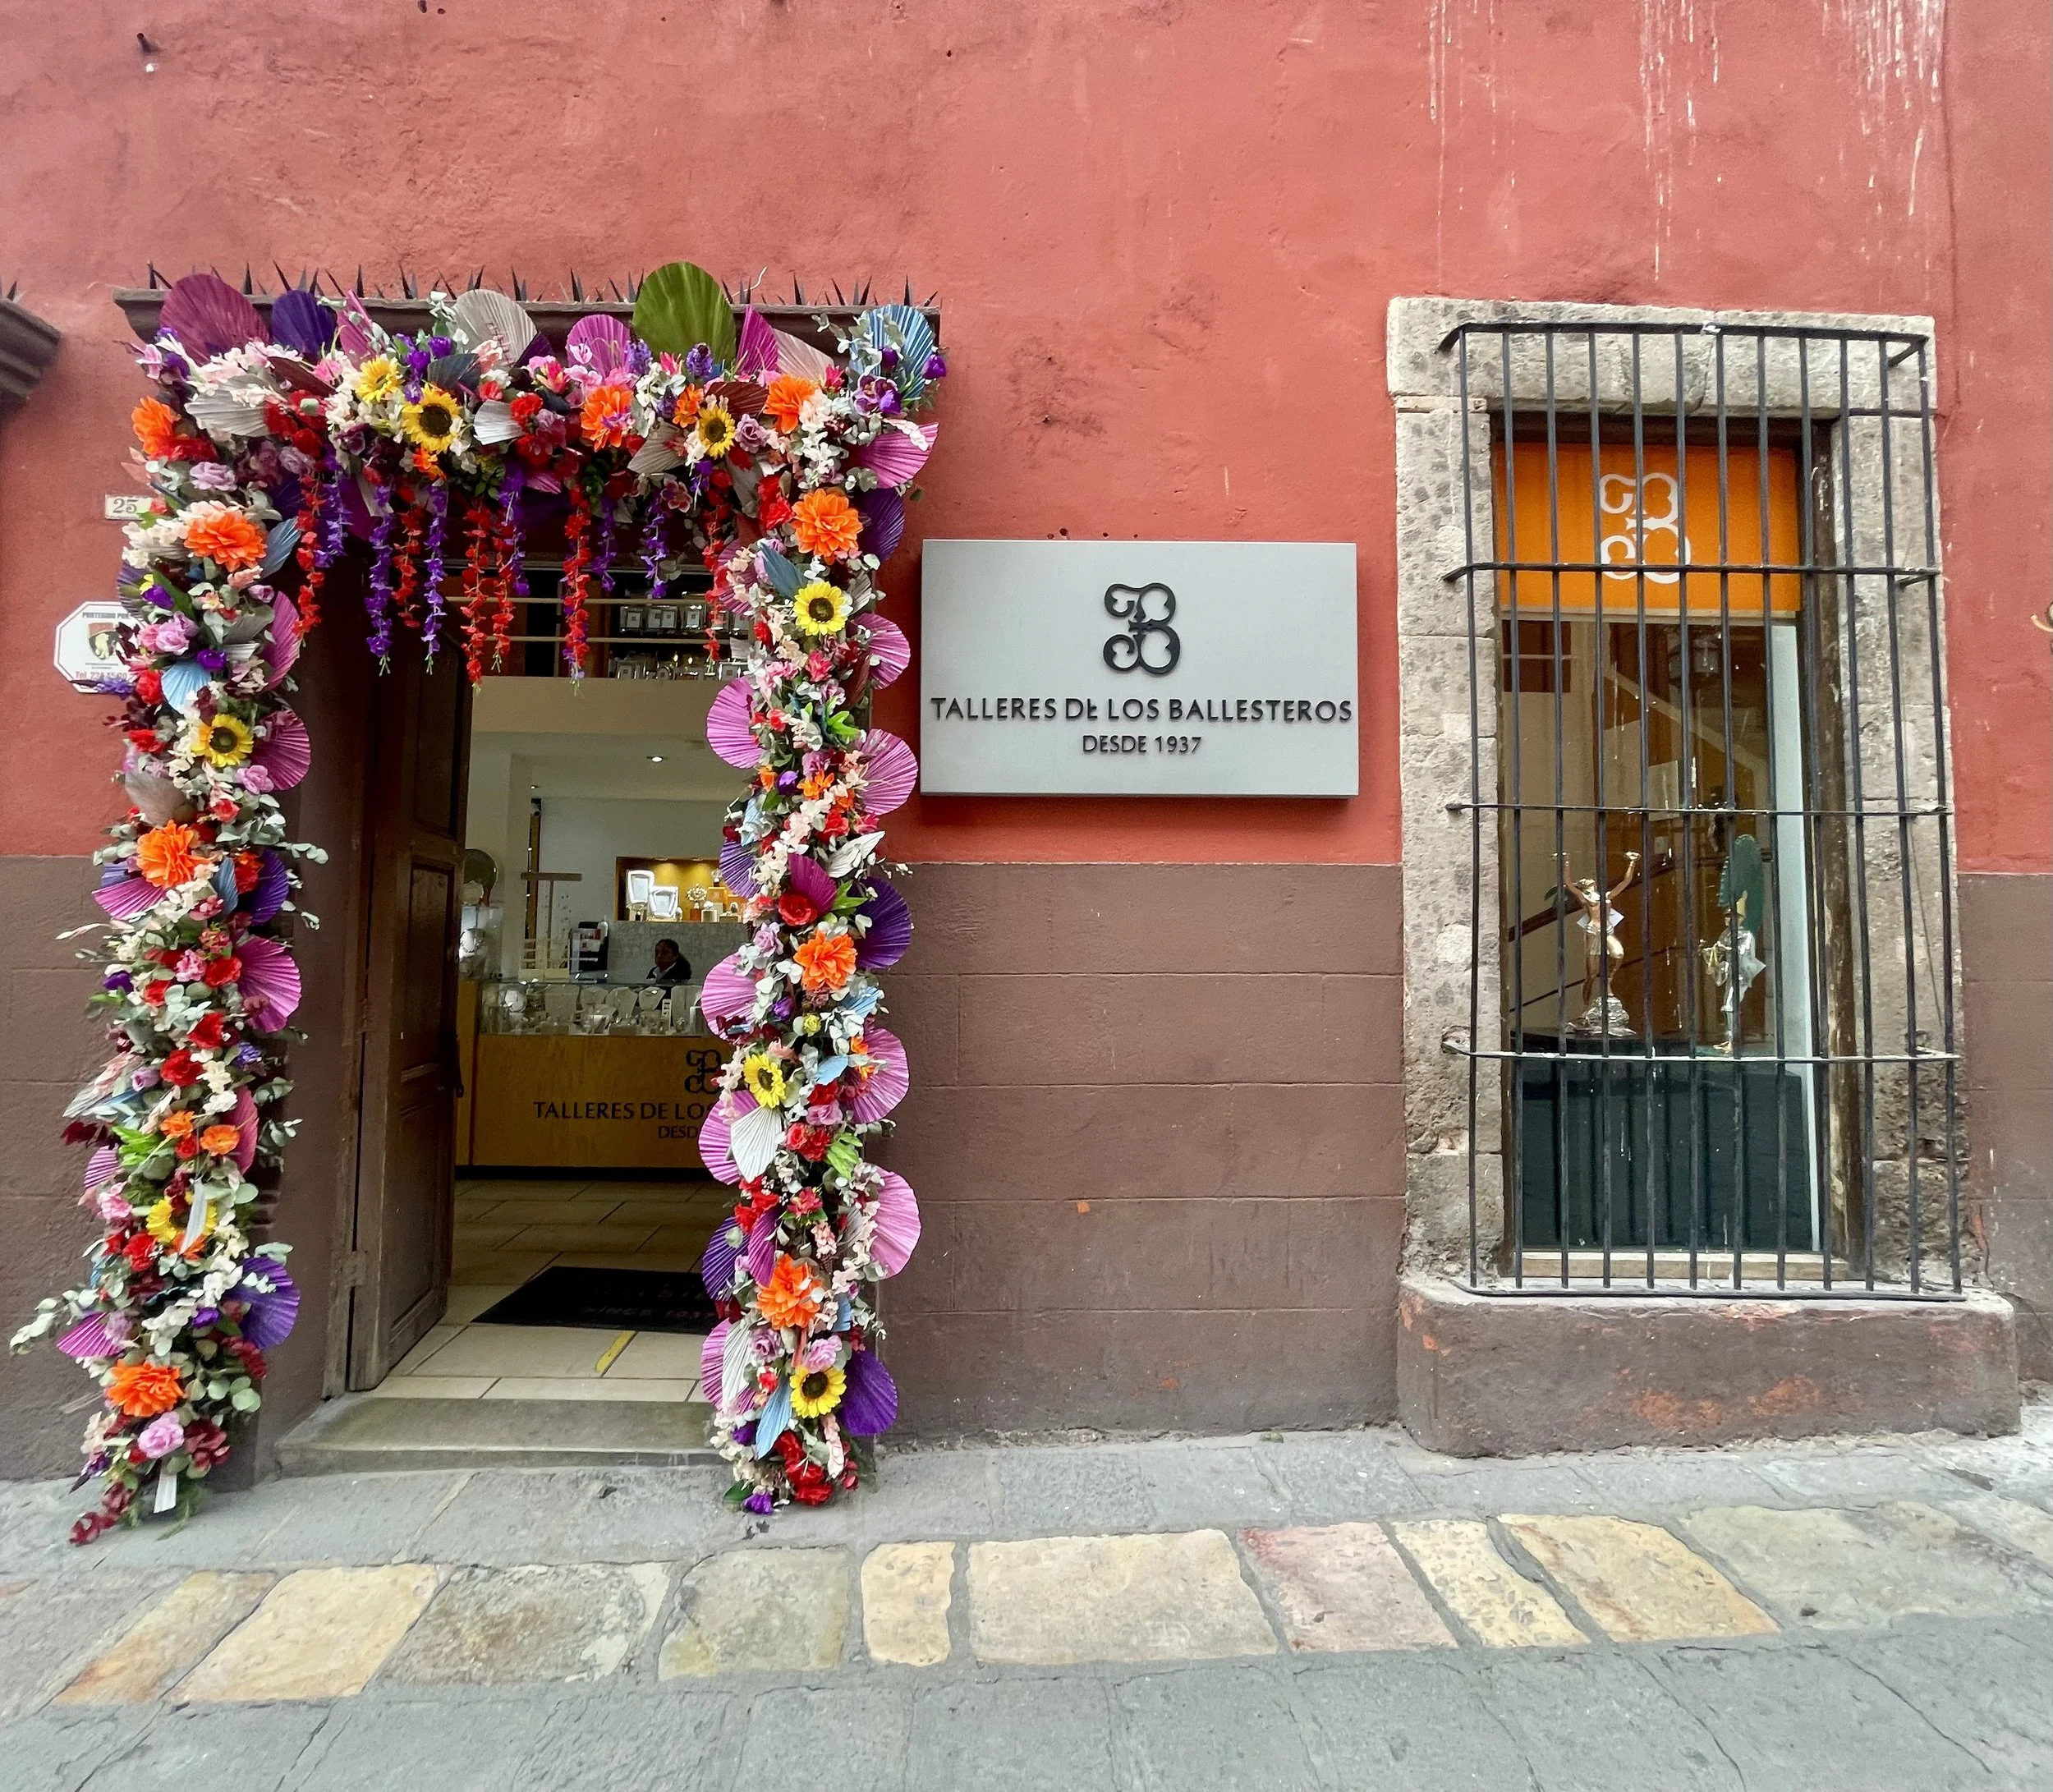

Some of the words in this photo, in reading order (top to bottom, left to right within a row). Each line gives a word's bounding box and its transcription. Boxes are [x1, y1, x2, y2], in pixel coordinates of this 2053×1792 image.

[113, 498, 139, 514] 25
[930, 697, 1057, 720] TALLERES
[1065, 698, 1098, 720] DE
[1108, 698, 1160, 721] LOS
[1169, 699, 1353, 722] BALLESTEROS
[1082, 735, 1147, 753] DESDE
[1155, 736, 1202, 753] 1937
[533, 1101, 636, 1119] TALLERES
[641, 1102, 668, 1120] DE
[658, 1125, 698, 1138] DESD
